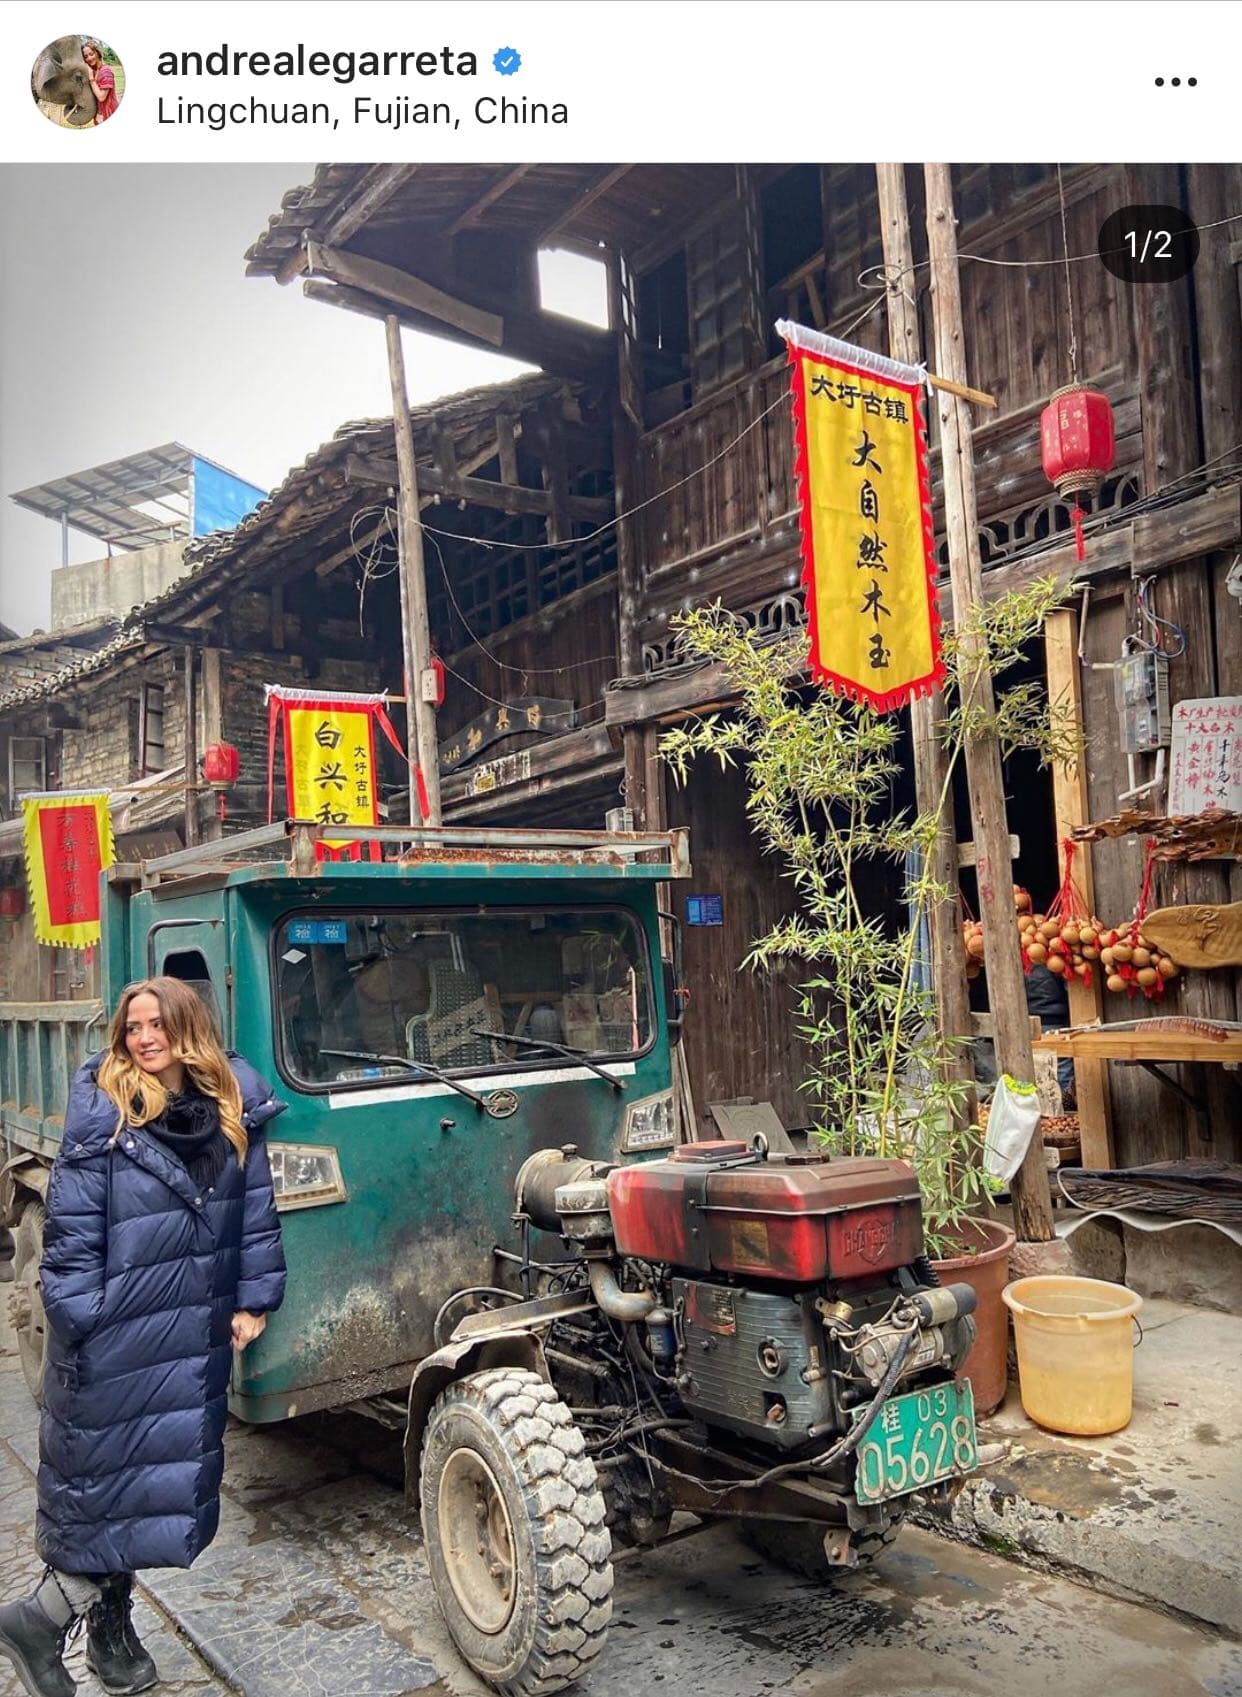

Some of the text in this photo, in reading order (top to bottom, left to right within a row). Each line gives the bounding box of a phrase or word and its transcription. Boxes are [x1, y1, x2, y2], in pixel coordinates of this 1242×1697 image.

[810, 374, 909, 424] 大圩古镇
[851, 430, 892, 669] 大自然木玉
[313, 720, 349, 824] 白兴和
[353, 745, 370, 808] 大圩古镇
[881, 1389, 948, 1434] 桂 03
[861, 1415, 975, 1499] 05628
